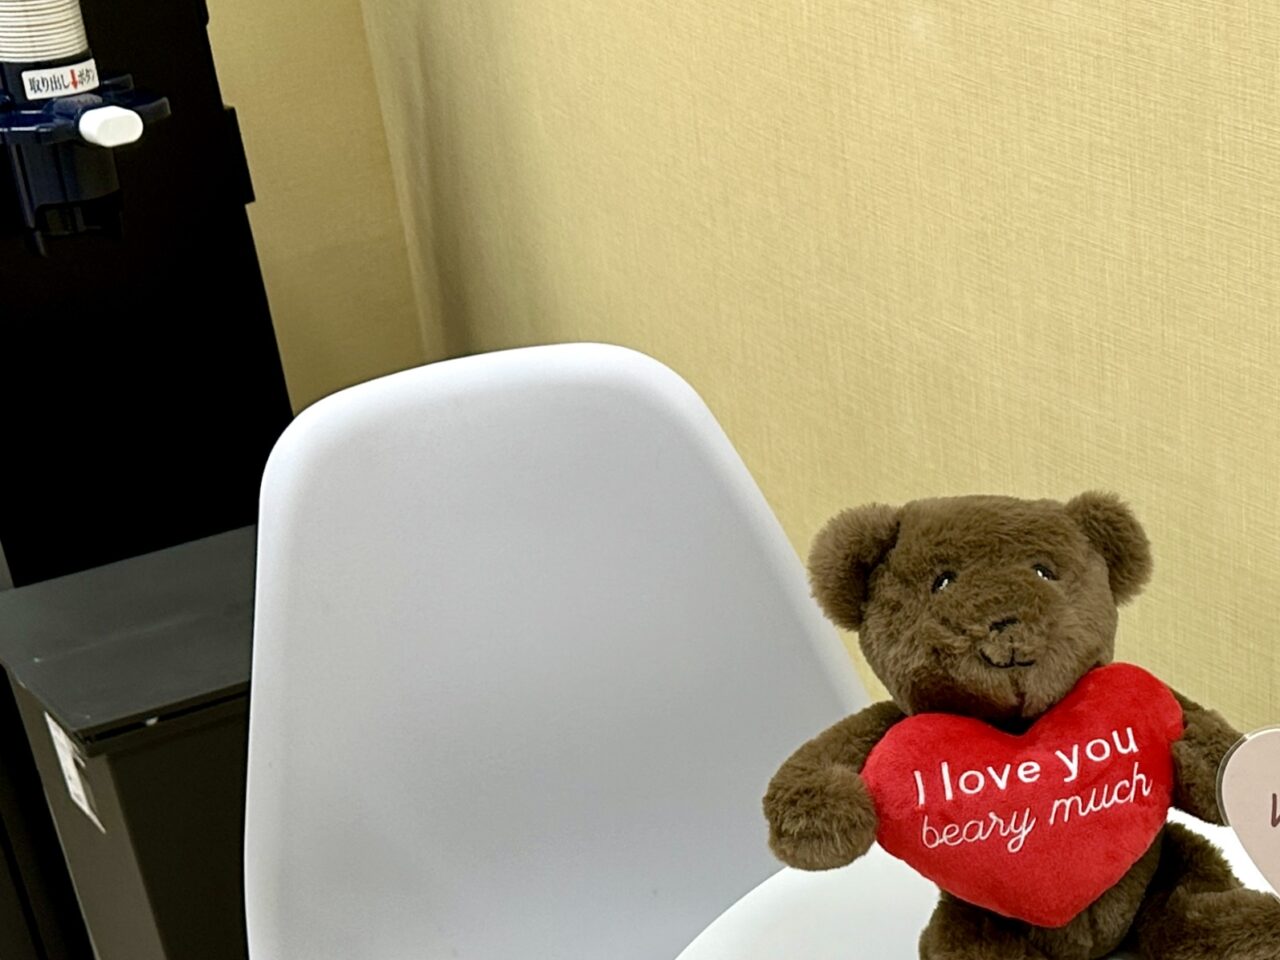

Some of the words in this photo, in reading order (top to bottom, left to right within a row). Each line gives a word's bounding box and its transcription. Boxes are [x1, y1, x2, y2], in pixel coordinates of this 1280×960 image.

[28, 74, 70, 94] 取り出し
[914, 770, 926, 806] I
[941, 756, 1042, 802] love
[1054, 726, 1139, 779] you
[921, 804, 1036, 854] beary
[1049, 761, 1153, 829] much
